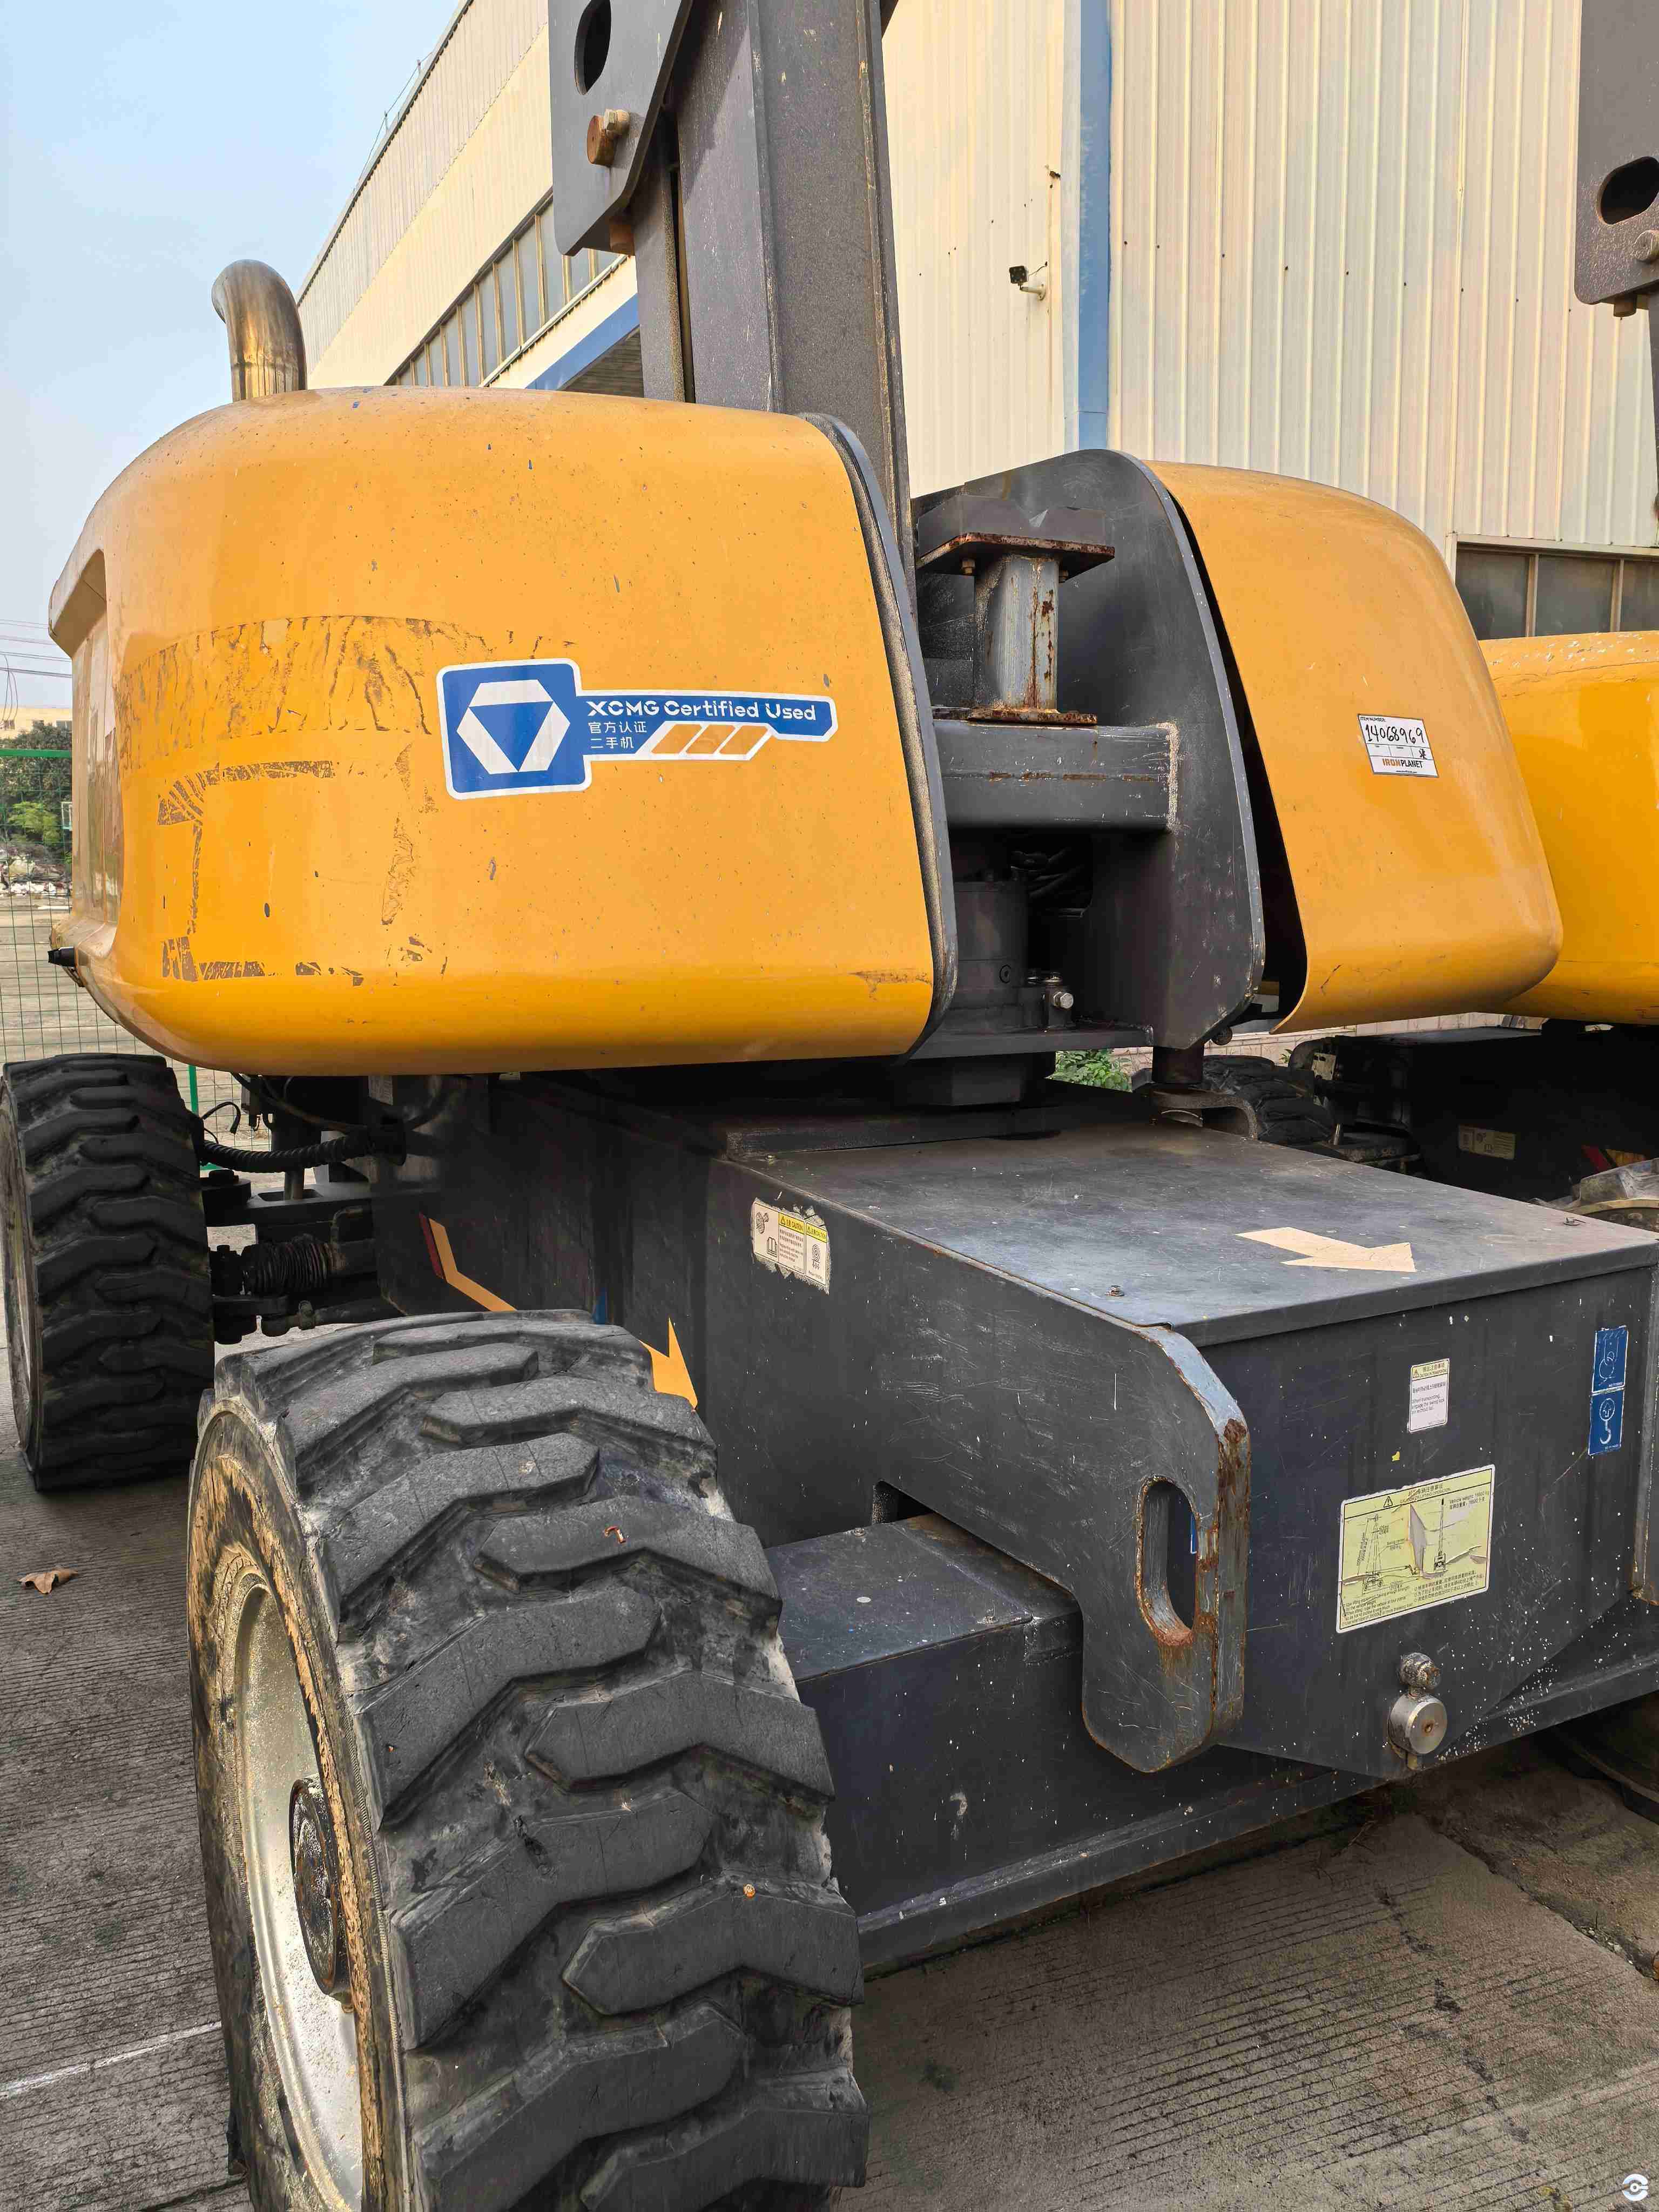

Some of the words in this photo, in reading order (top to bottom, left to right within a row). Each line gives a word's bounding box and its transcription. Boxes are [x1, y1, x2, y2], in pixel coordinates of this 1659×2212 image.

[586, 700, 660, 718] XCMG
[664, 700, 759, 718] Certified
[766, 703, 817, 721] Used
[588, 721, 648, 734] 官方认证
[1365, 724, 1425, 744] 14068969
[590, 736, 635, 749] 二手机
[1382, 758, 1424, 768] IRONPLANET
